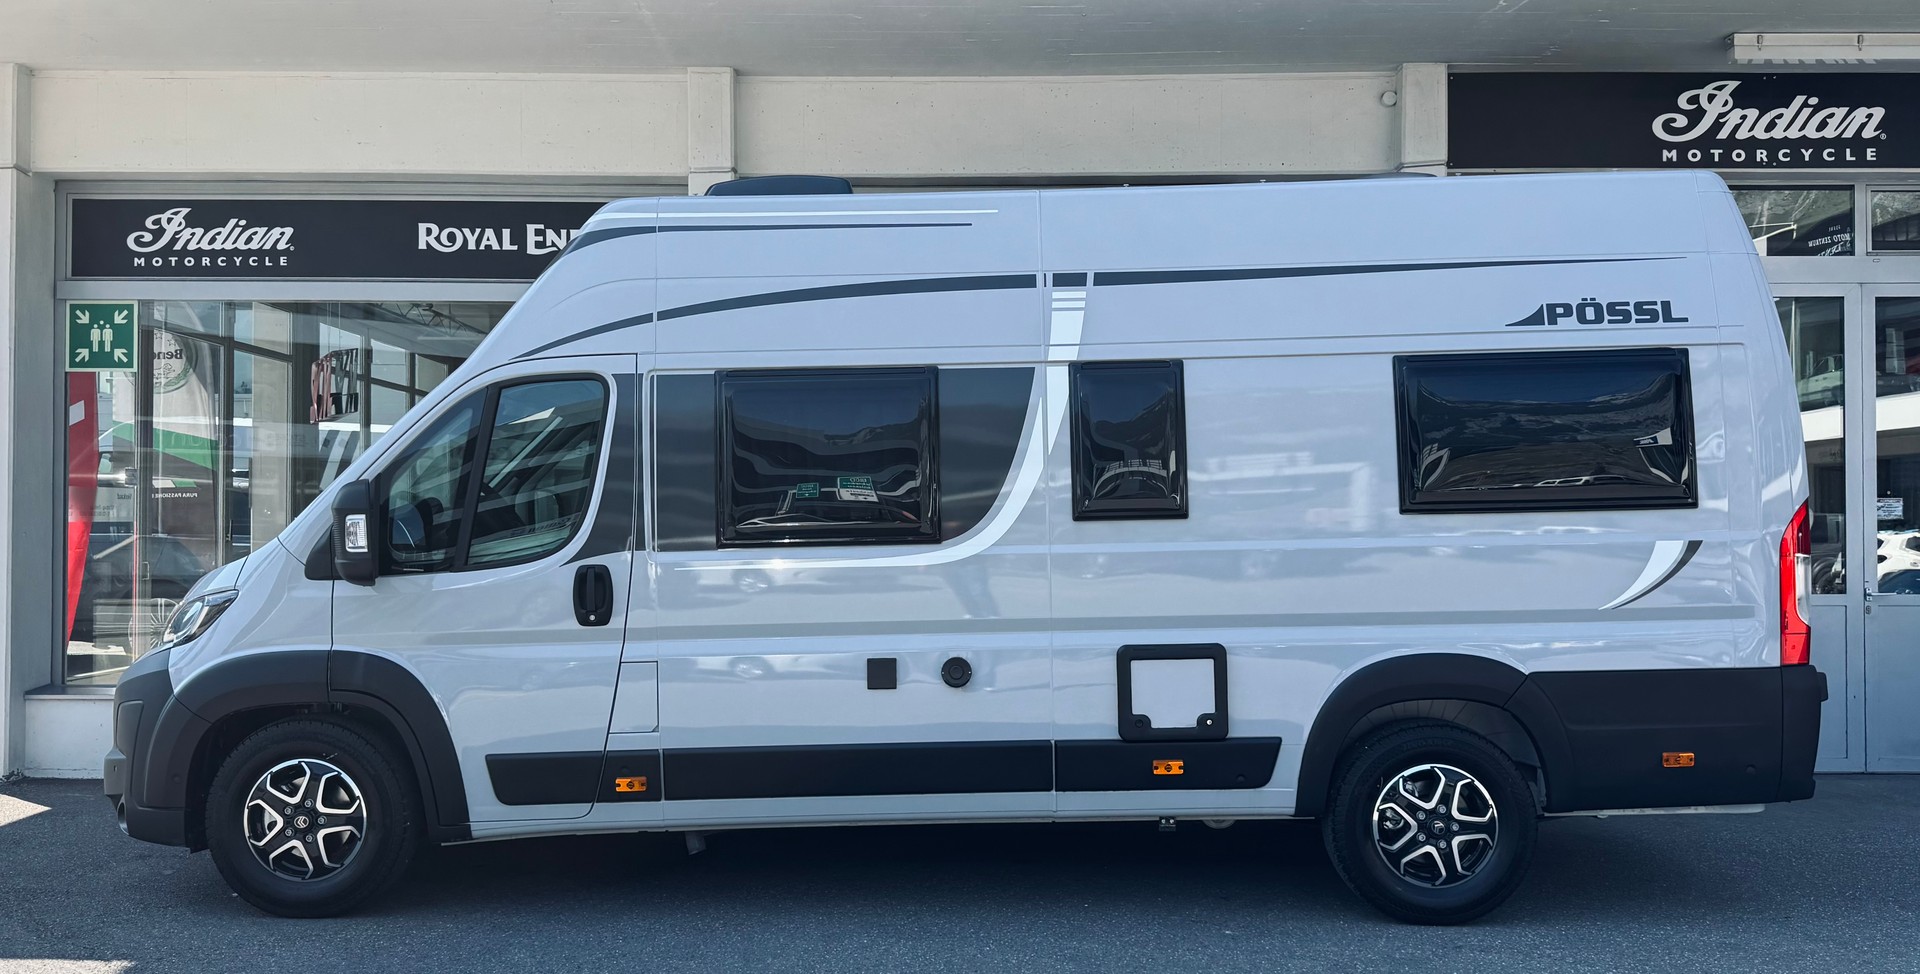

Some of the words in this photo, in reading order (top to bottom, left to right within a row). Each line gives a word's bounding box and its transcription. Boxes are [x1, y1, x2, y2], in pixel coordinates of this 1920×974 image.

[1652, 80, 1886, 142] Indian
[1662, 148, 1877, 162] MOTORCYCLE
[127, 207, 294, 252] Indian
[418, 222, 518, 253] ROYAL
[134, 256, 288, 267] MOTORCYCLE
[1545, 297, 1689, 326] PÖSSL
